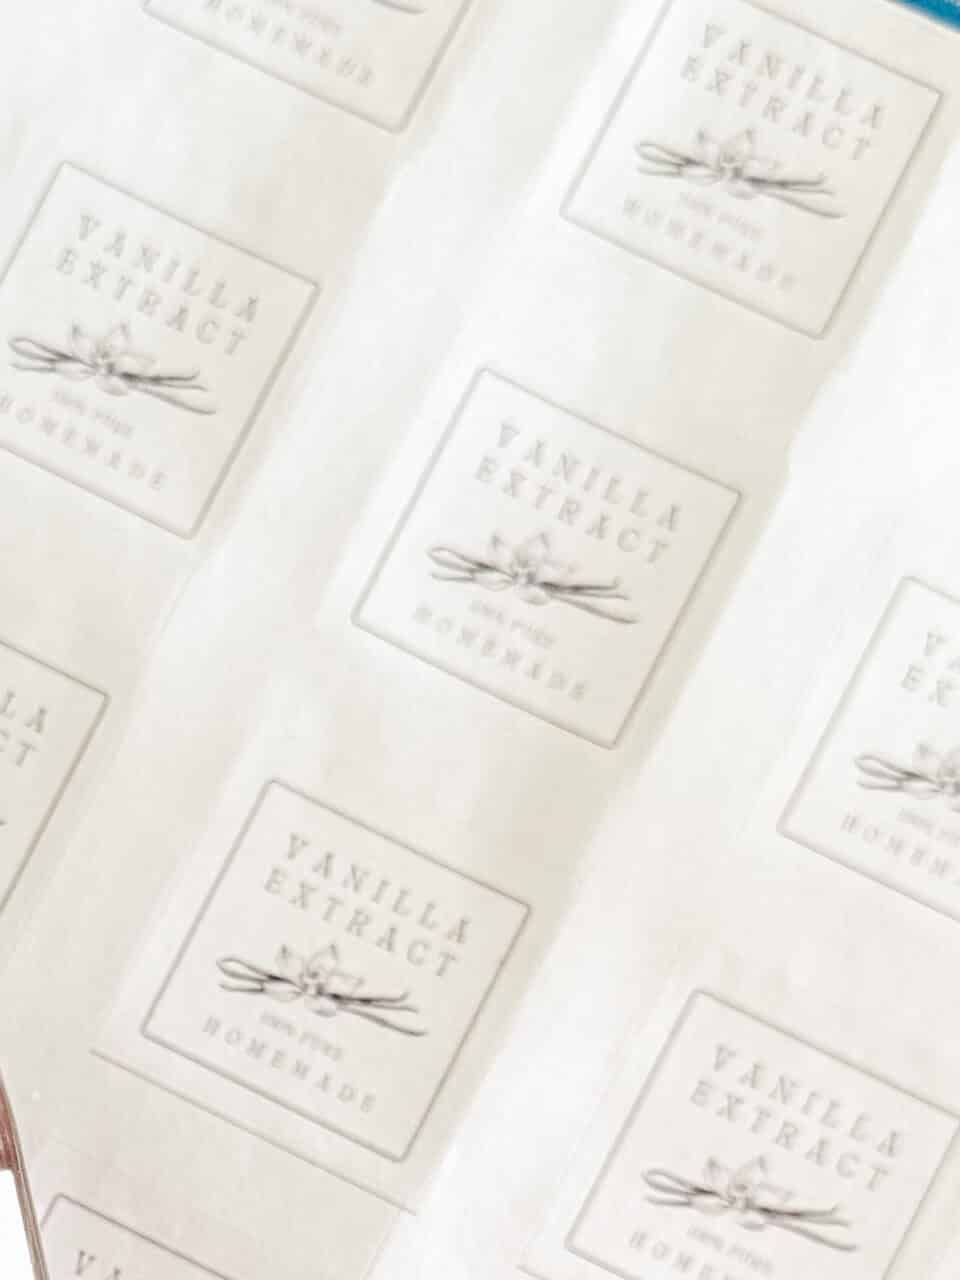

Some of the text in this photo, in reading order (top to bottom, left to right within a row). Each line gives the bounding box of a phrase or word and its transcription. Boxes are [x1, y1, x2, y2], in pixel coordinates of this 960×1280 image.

[704, 22, 886, 129] VANILLA
[56, 248, 249, 356] EXTRACT
[77, 213, 261, 324] VANILLA
[475, 456, 669, 564] EXTRACT
[498, 420, 682, 532] VANILLA
[263, 867, 458, 979] EXTRACT
[287, 831, 472, 946] VANILLA
[202, 1014, 377, 1114] HOMEMADE
[713, 1043, 901, 1158] VANILLA
[689, 1079, 888, 1193] EXTRACT
